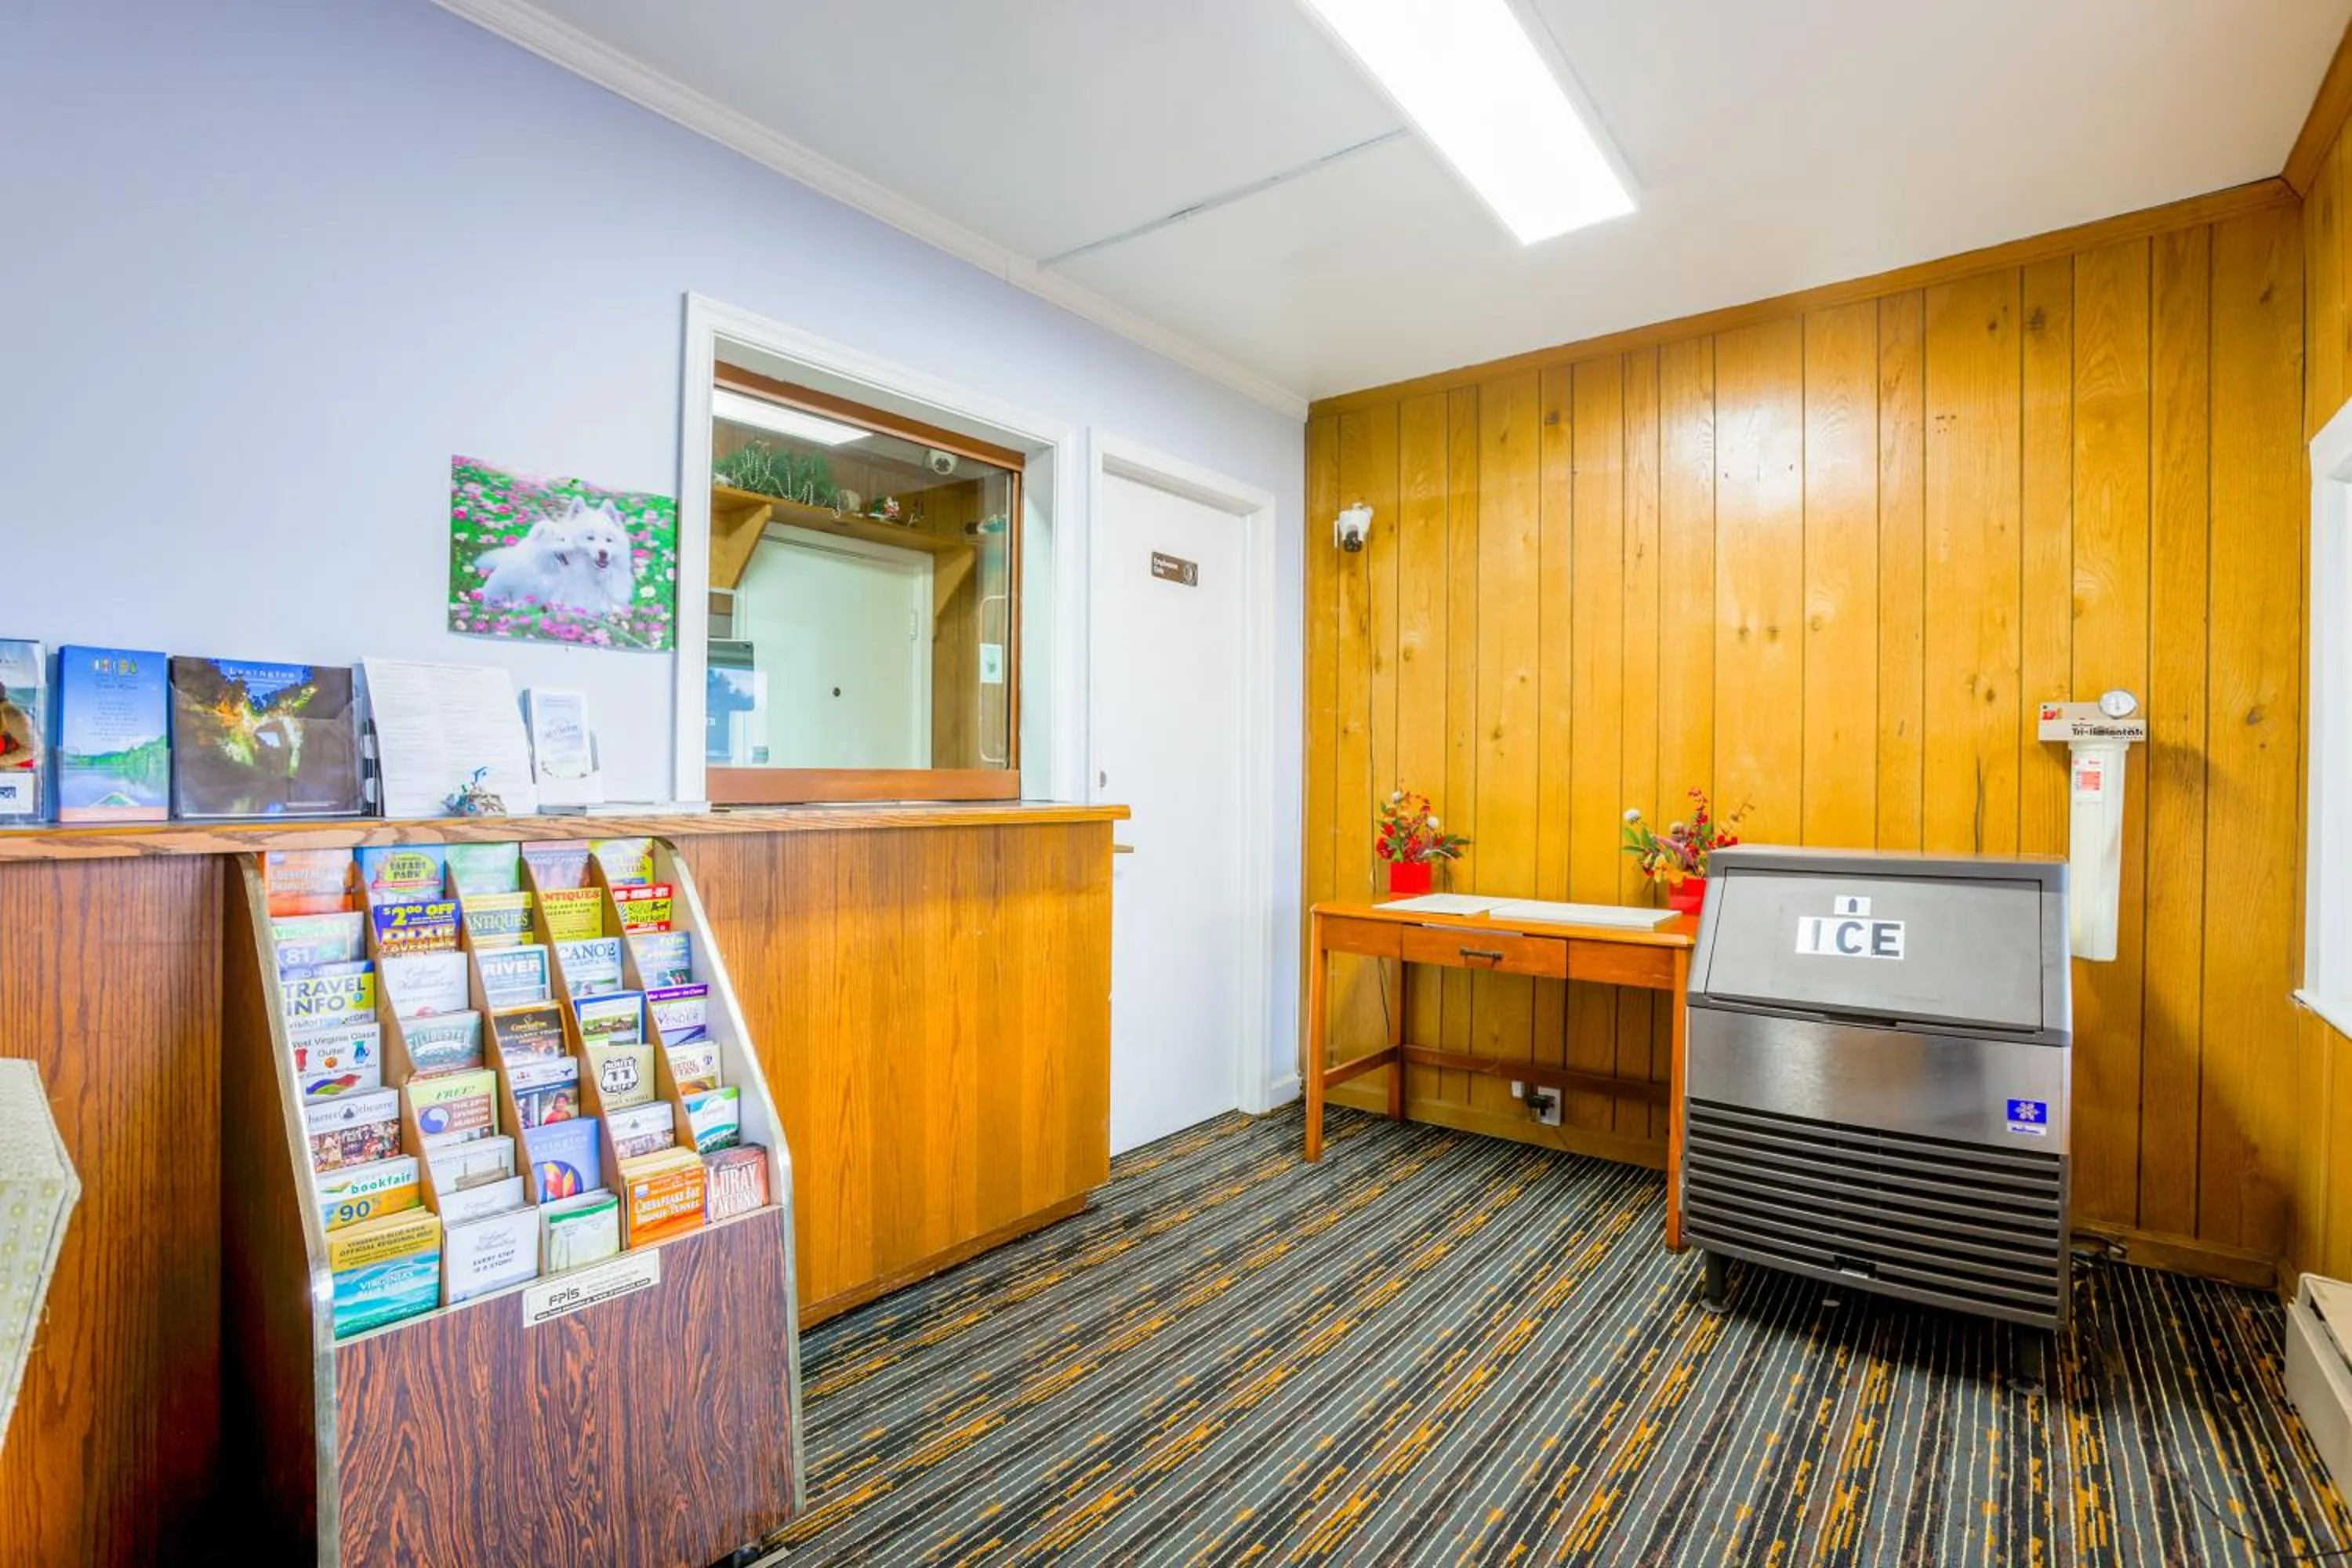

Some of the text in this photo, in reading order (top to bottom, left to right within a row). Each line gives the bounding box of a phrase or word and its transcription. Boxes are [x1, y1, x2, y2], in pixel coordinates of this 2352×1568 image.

[542, 890, 601, 902] NTIQUES
[426, 902, 456, 917] OFF
[1812, 919, 1901, 956] ICE
[286, 948, 310, 964] 81
[481, 959, 541, 977] RIVER
[282, 976, 366, 998] TRAVEL
[287, 996, 346, 1016] INFO
[608, 1069, 631, 1081] 11
[351, 1173, 412, 1195] bookfair
[708, 1163, 757, 1199] LURAY
